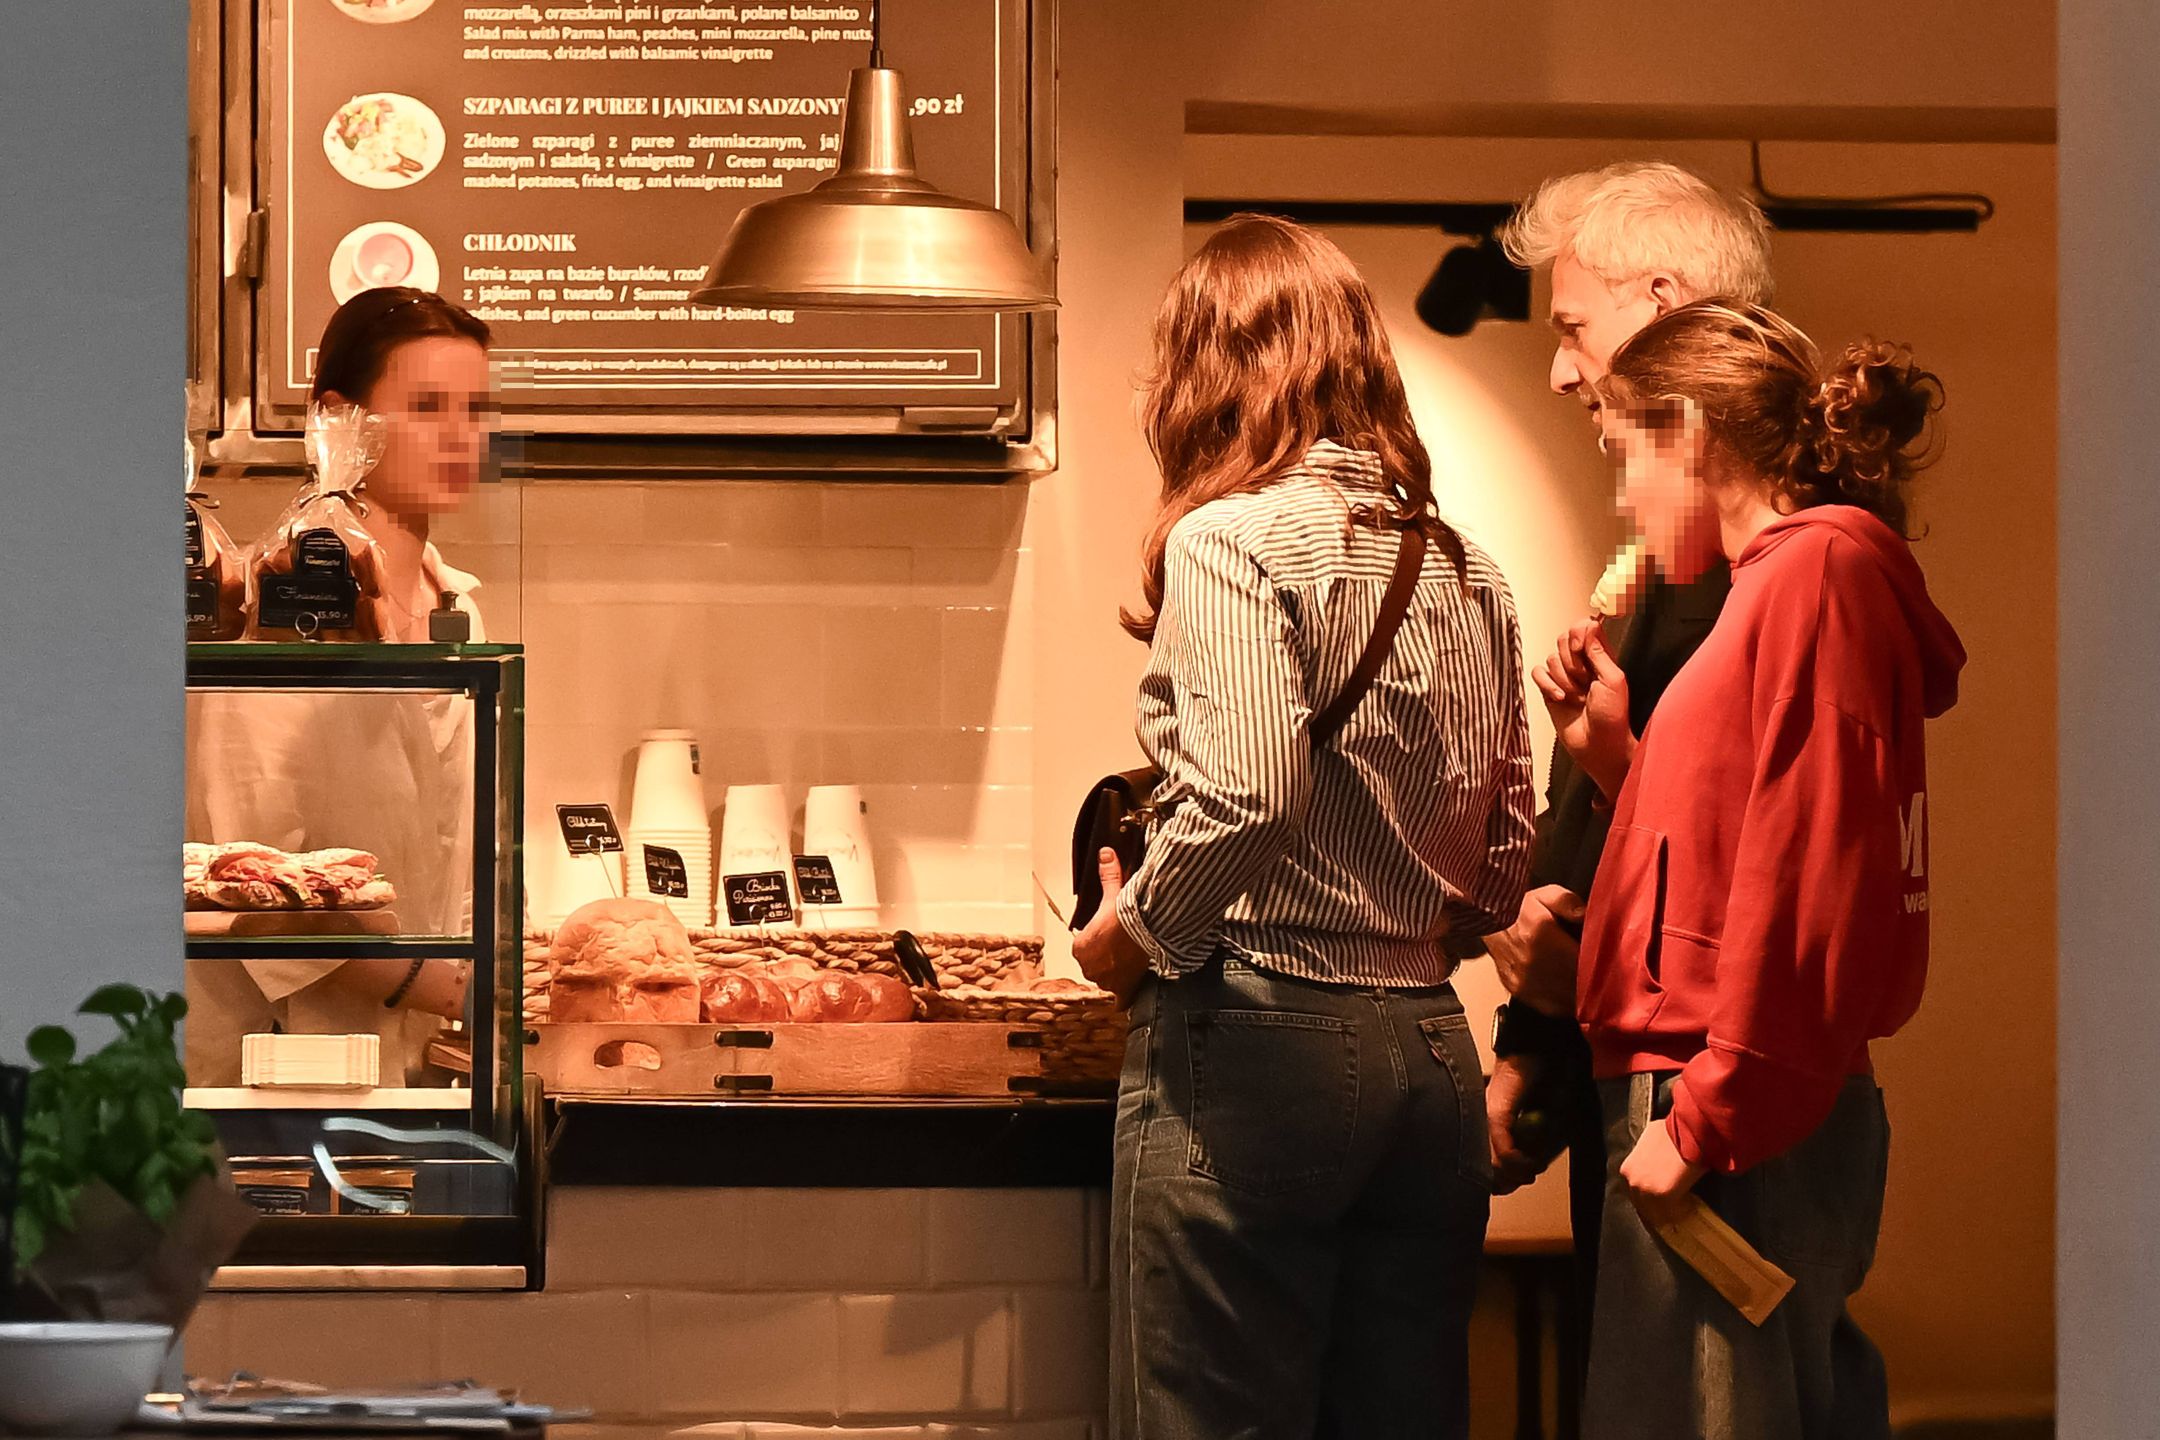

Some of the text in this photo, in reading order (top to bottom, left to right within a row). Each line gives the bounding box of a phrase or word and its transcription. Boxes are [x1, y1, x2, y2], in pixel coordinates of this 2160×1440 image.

[545, 5, 622, 20] orzeszkami
[625, 6, 651, 23] pini
[662, 5, 739, 23] grzankami,
[741, 6, 788, 23] polane
[790, 6, 860, 20] balsamico
[463, 26, 501, 39] Salad
[503, 27, 528, 39] mix
[530, 26, 560, 39] with
[562, 27, 605, 39] Parma
[607, 26, 641, 41] ham,
[643, 26, 699, 42] peaches,
[702, 27, 731, 39] mini
[734, 27, 809, 41] mozzarella,
[811, 27, 841, 43] pine
[463, 46, 773, 63] and croutons, drizzled with balsamic vinaigrette
[463, 98, 562, 114] SZPARAGI
[566, 98, 579, 114] Z
[583, 98, 648, 114] PUREE
[651, 98, 660, 114] I
[662, 98, 743, 118] JAJKIEM
[747, 98, 846, 116] SADZONY
[944, 94, 964, 113] zł
[463, 133, 520, 148] Zielone
[532, 134, 595, 153] szparagi
[608, 137, 618, 148] z
[631, 137, 675, 151] puree
[688, 134, 807, 151] ziemniaczanym,
[463, 153, 535, 170] sadzonym
[605, 156, 615, 168] z
[619, 153, 695, 171] vinaigrette
[707, 153, 715, 169] /
[726, 155, 766, 168] Green
[463, 174, 783, 190] mashed potatoes, fried egg, and vinaigrette salad
[463, 234, 577, 251] CHŁODNIK
[463, 266, 507, 280] Letnia
[509, 270, 544, 283] zupa
[546, 269, 565, 280] na
[567, 266, 606, 281] bazie
[607, 266, 671, 282] buraków,
[463, 289, 473, 300] z
[537, 289, 557, 300] na
[563, 285, 614, 300] twardo
[619, 286, 629, 302] /
[633, 287, 690, 300] Summer
[524, 307, 551, 320] and
[551, 310, 591, 323] green
[592, 307, 656, 320] cucumber
[658, 307, 690, 320] with
[691, 307, 767, 320] hard-boiled
[769, 310, 795, 323] egg
